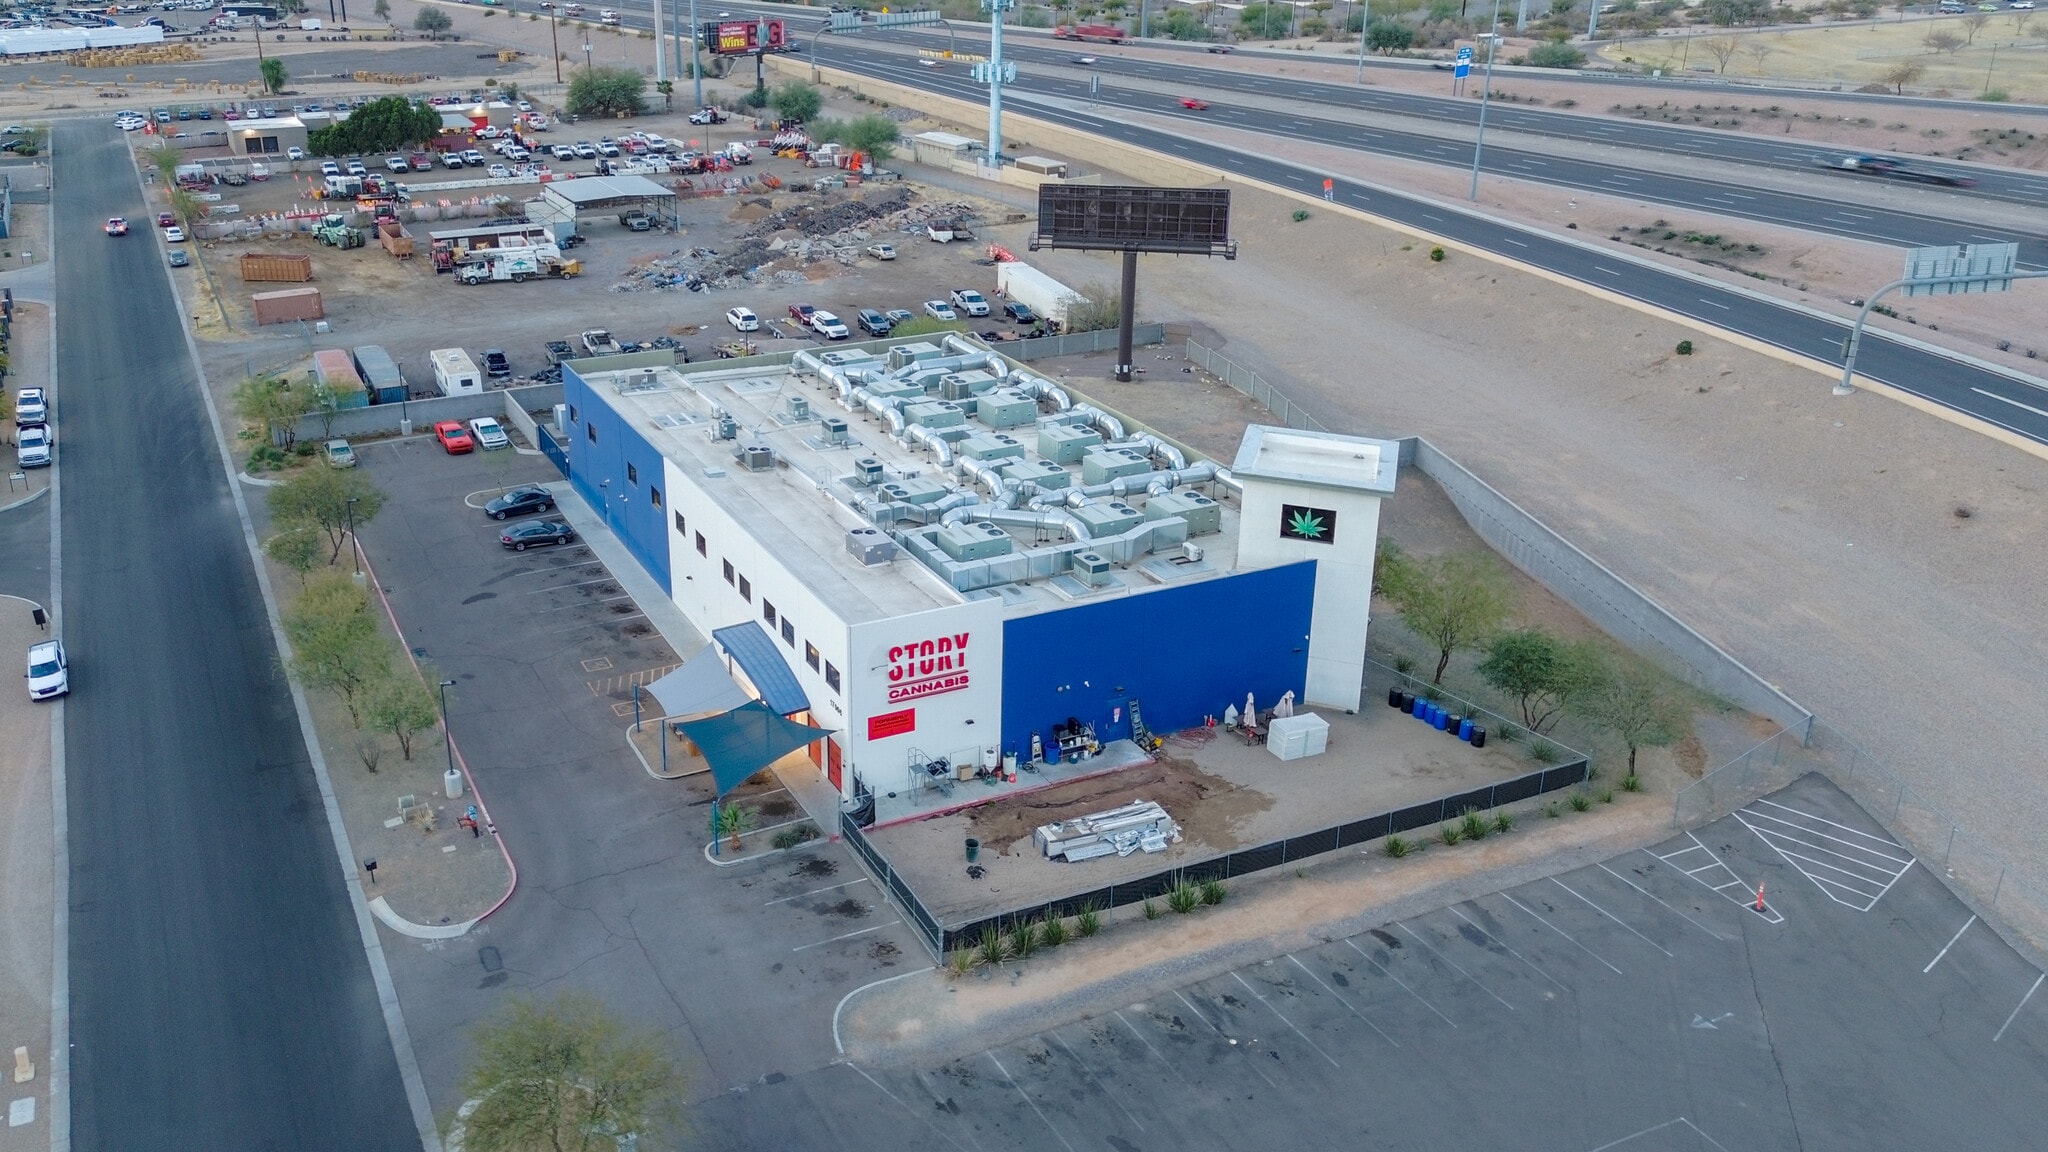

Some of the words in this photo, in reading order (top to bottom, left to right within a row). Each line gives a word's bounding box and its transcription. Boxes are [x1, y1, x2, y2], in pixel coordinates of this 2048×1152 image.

[721, 36, 745, 48] Wins
[747, 22, 780, 47] BG
[888, 632, 970, 682] STORY
[888, 675, 970, 699] CANNABIS
